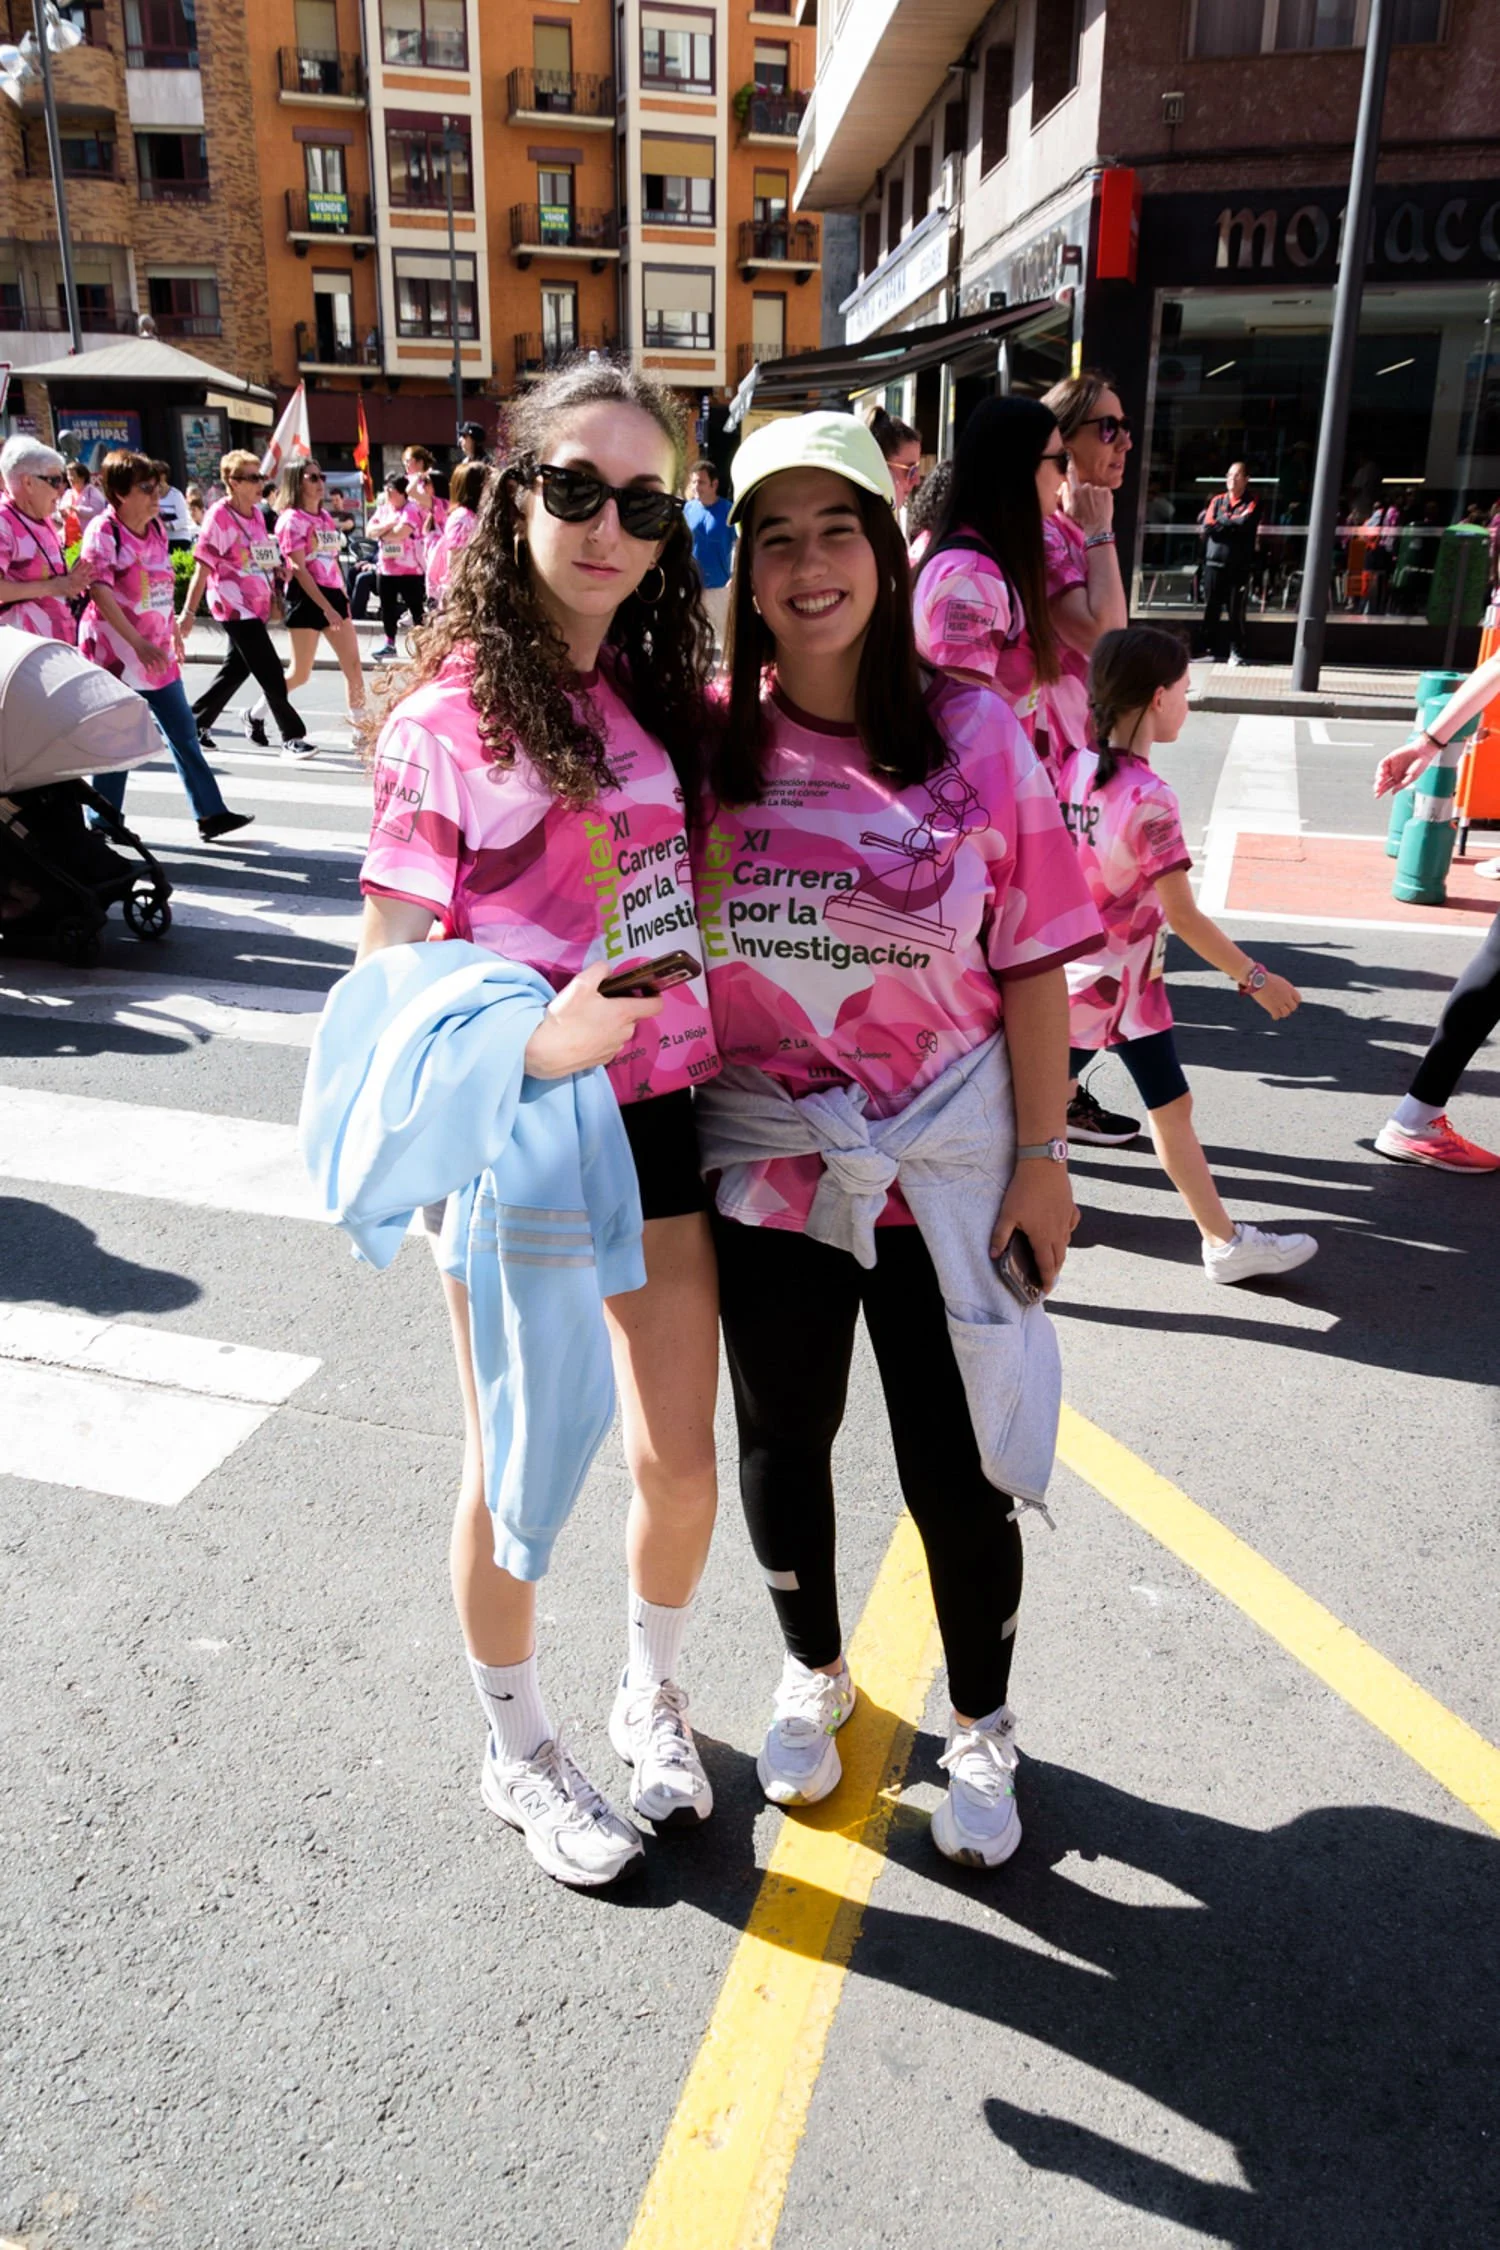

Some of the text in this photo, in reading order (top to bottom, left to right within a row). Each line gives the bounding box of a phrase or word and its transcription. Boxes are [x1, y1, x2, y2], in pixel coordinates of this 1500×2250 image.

[91, 429, 129, 443] PIPAS
[768, 798, 779, 807] La
[781, 798, 804, 809] Rioja
[610, 811, 631, 842] XI
[740, 829, 771, 852] XI
[617, 834, 689, 877] Carrera
[584, 820, 625, 960] mujer
[697, 824, 737, 958] mujer
[733, 861, 853, 891] Carrera
[622, 873, 675, 920] por la
[626, 899, 698, 949] Investi
[728, 897, 817, 928] por la
[732, 931, 931, 970] Investigación
[672, 1027, 708, 1046] La Rioja
